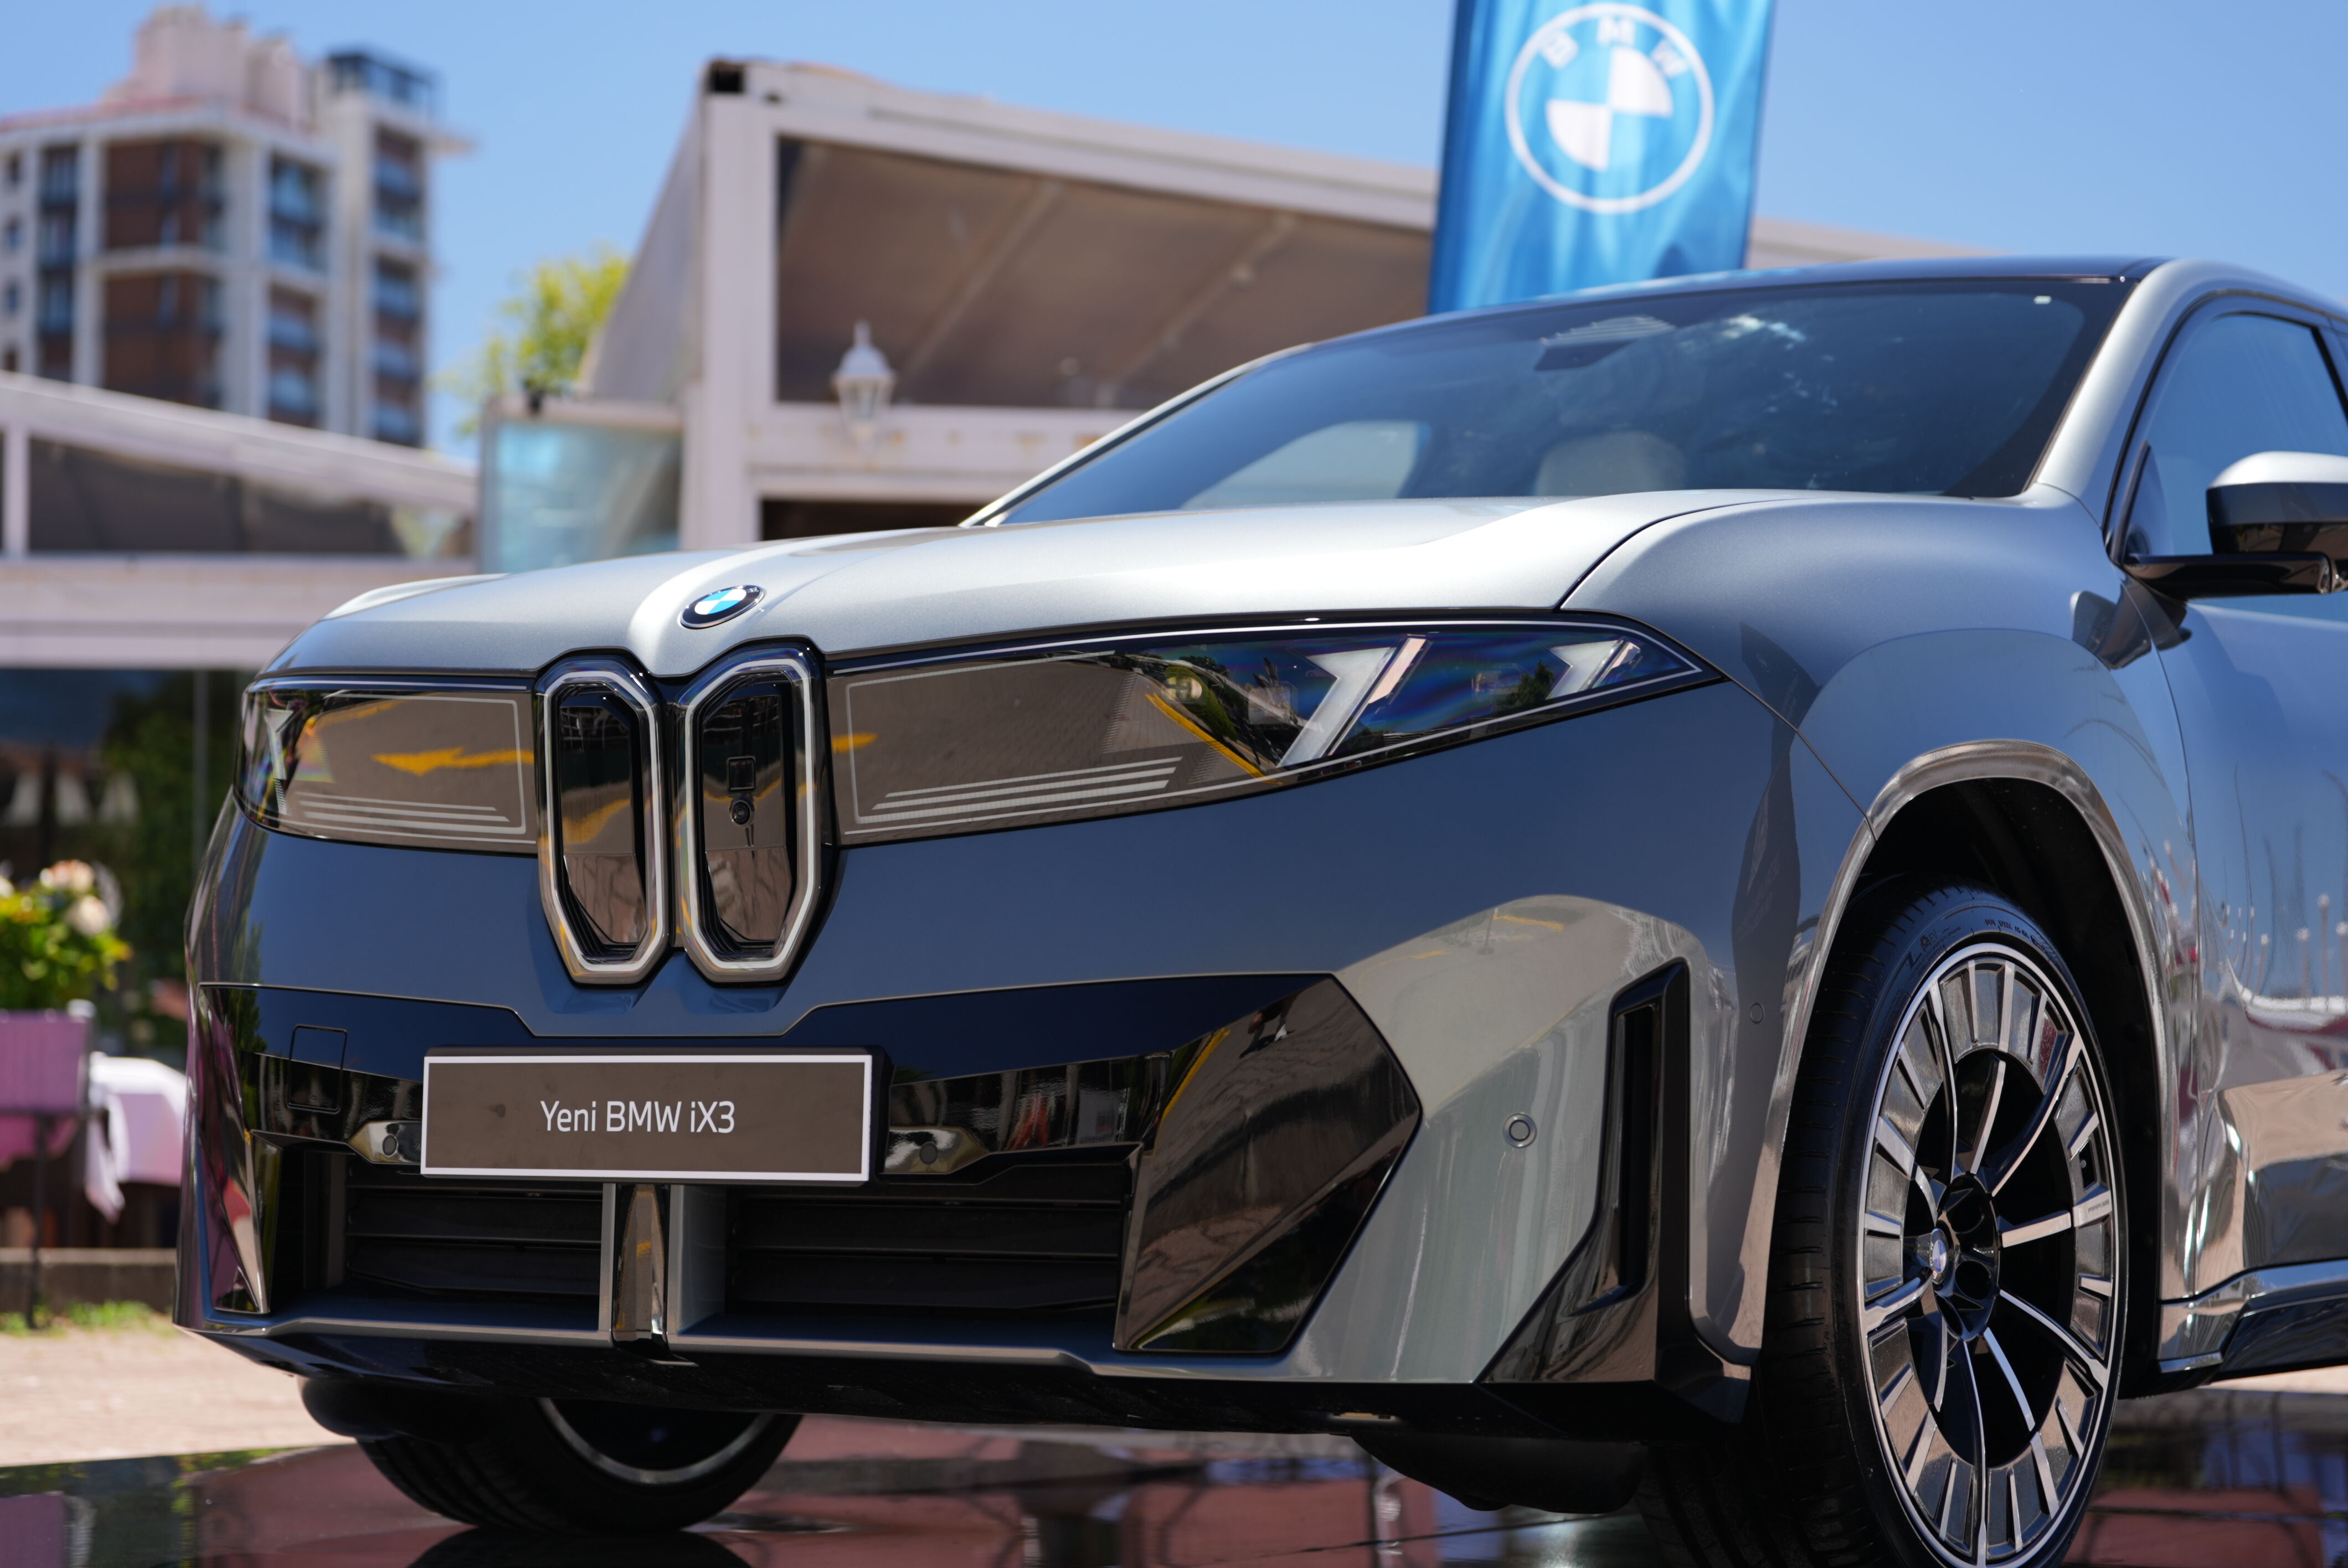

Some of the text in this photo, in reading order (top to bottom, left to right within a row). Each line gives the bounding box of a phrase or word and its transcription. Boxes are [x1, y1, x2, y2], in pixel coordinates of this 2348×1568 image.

[1540, 15, 1688, 78] BMW
[540, 1101, 735, 1133] Yeni BMW iX3
